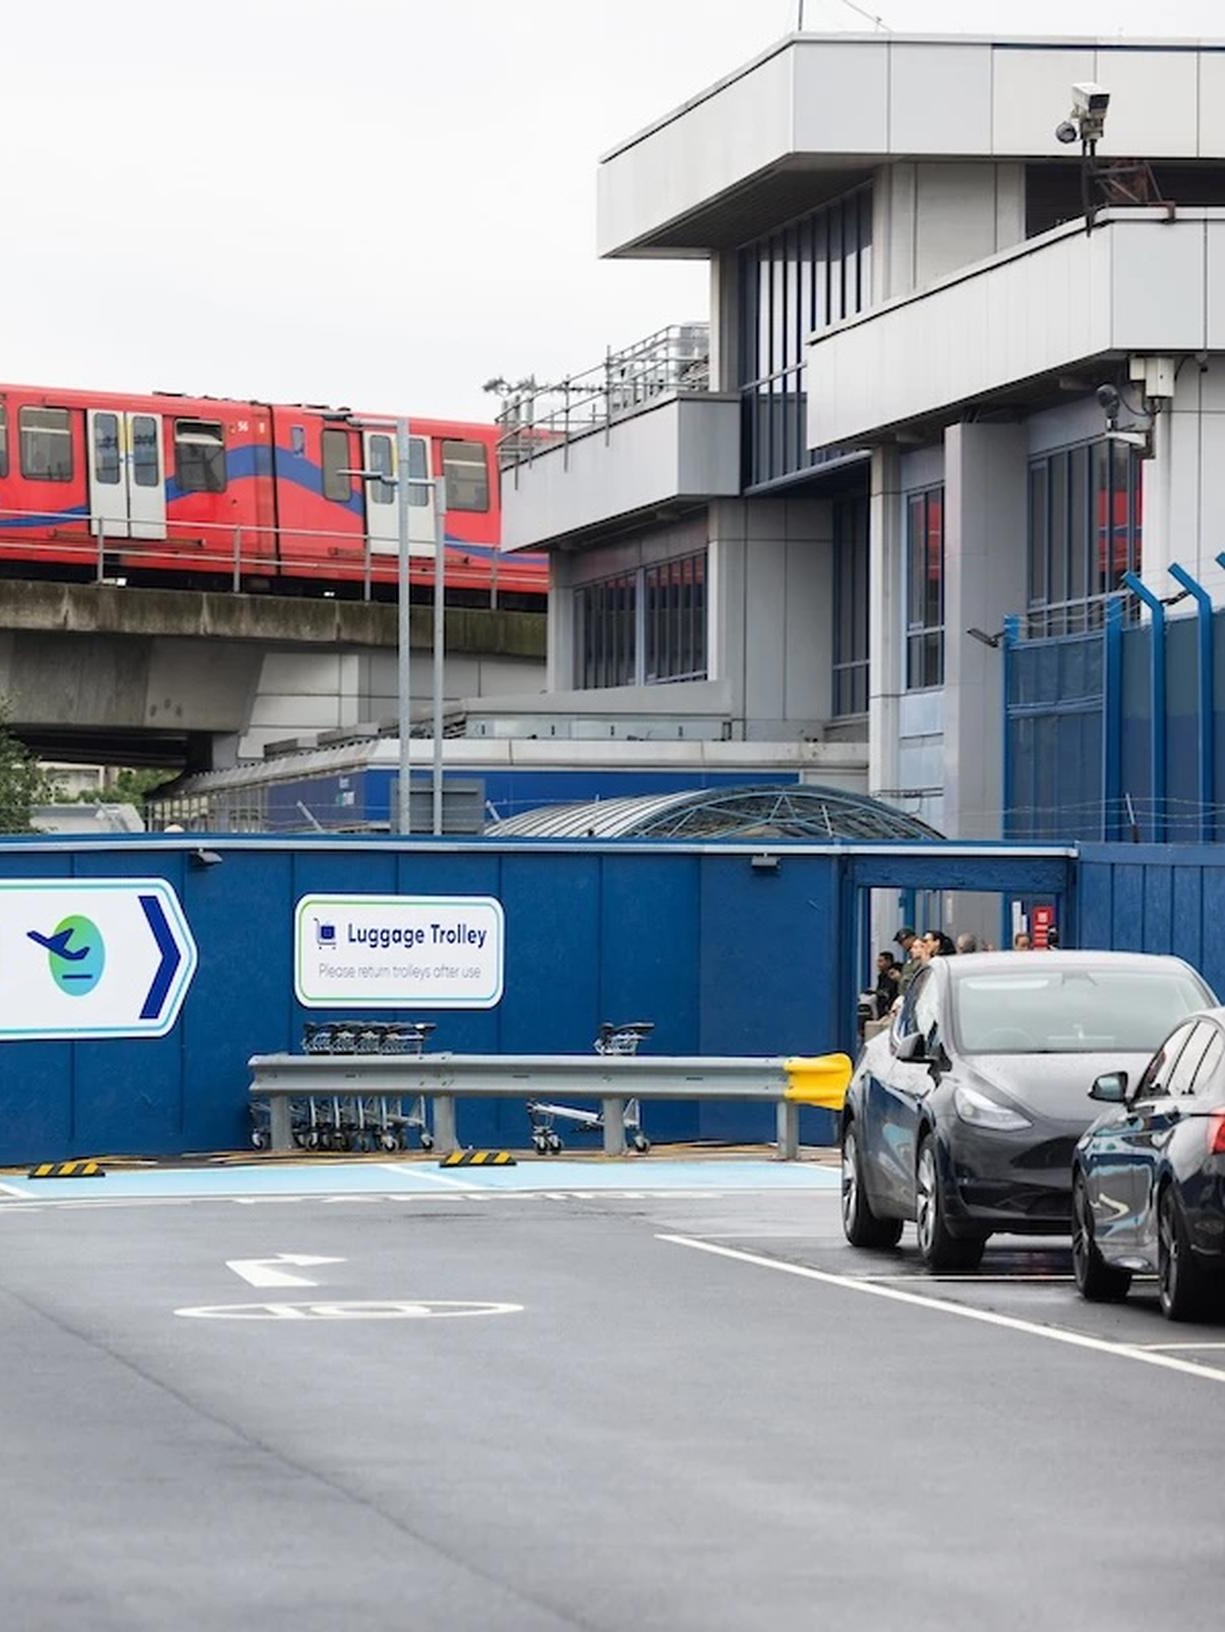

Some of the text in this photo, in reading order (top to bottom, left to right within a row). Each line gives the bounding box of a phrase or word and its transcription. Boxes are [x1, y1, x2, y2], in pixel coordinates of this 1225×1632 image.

[348, 923, 487, 949] Luggage Trolley
[318, 963, 482, 981] Please return trolleys after use
